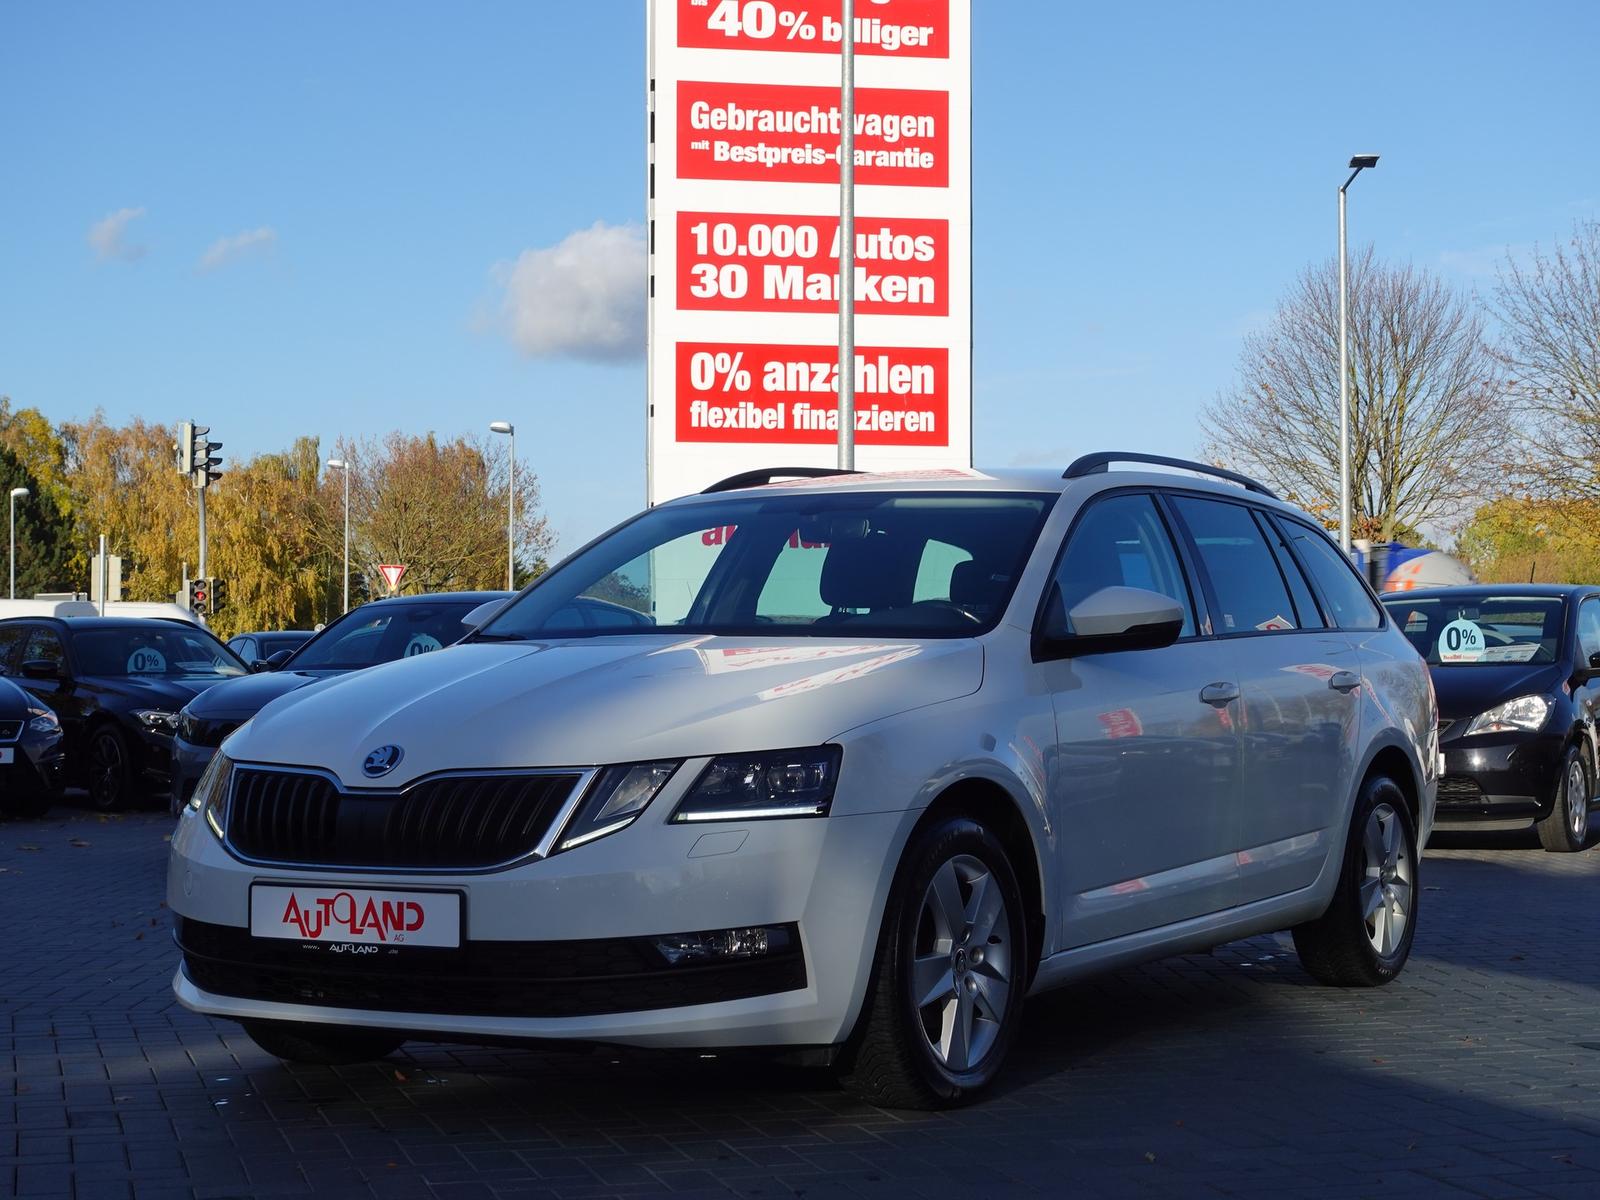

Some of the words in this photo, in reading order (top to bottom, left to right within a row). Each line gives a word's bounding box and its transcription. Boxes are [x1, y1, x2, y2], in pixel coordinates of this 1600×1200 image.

[707, 0, 816, 40] 40%
[822, 16, 934, 50] blliger
[690, 140, 710, 151] mit
[690, 222, 818, 258] 10.000
[690, 263, 748, 299] 30
[690, 352, 751, 392] 0%
[690, 401, 785, 429] flexibel
[792, 402, 935, 432] finazieren
[1446, 626, 1477, 651] 0%
[134, 653, 160, 671] 0%
